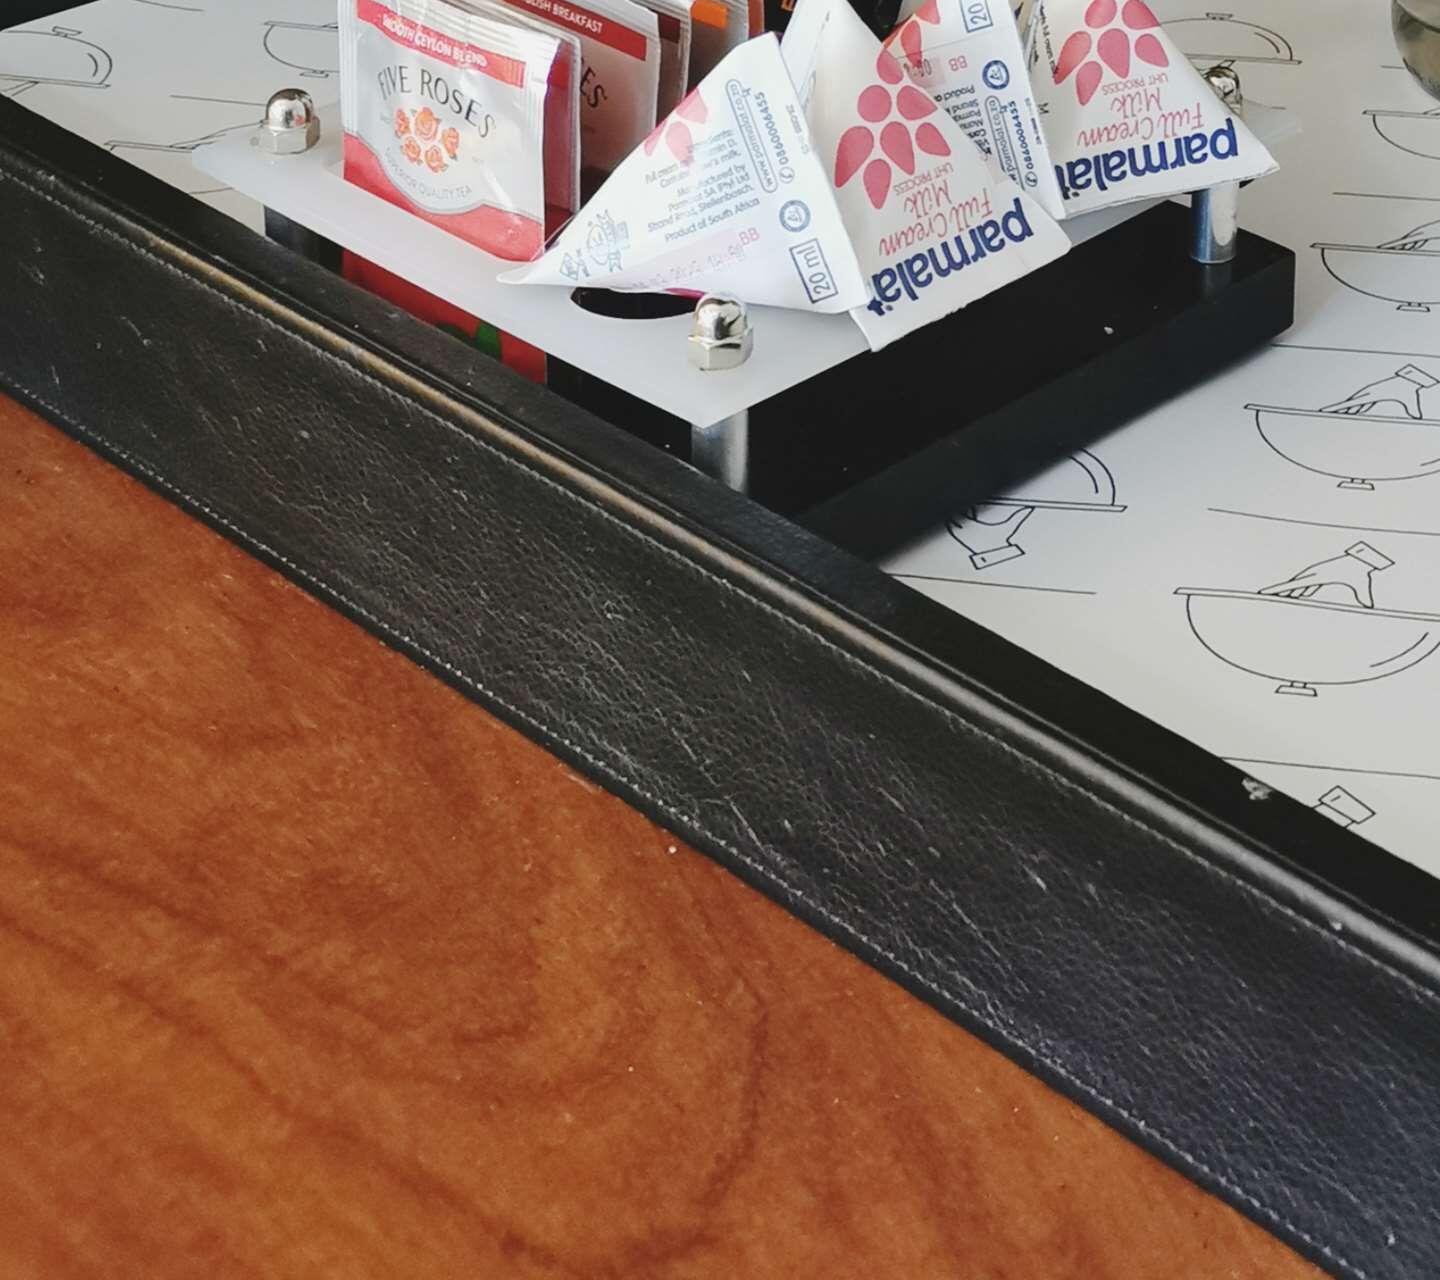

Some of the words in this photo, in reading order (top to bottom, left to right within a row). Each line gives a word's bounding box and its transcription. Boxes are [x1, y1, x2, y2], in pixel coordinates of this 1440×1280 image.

[550, 3, 604, 33] BREAKFAST
[968, 0, 987, 24] 20
[415, 29, 451, 55] CEYLON
[452, 47, 488, 67] BLEND
[948, 55, 968, 72] BB
[1148, 72, 1169, 85] UHT
[377, 65, 411, 100] FIVE
[420, 67, 496, 139] ROSES
[943, 84, 976, 101] Product
[1103, 79, 1146, 96] PROCESS
[1110, 87, 1162, 119] Milk
[753, 89, 788, 166] 0860006455
[1009, 100, 1034, 171] 0860006455
[1077, 117, 1154, 148] Cream
[1157, 102, 1205, 139] Full
[893, 171, 933, 196] PROCESS
[933, 162, 955, 179] UHT
[903, 180, 952, 218] Milk
[952, 187, 994, 232] Full
[663, 223, 697, 243] Product
[696, 218, 708, 230] of
[707, 208, 735, 225] South
[733, 197, 761, 214] Africa
[879, 212, 950, 257] Cream
[740, 226, 759, 247] BB
[795, 244, 820, 270] ml
[807, 270, 830, 295] 20
